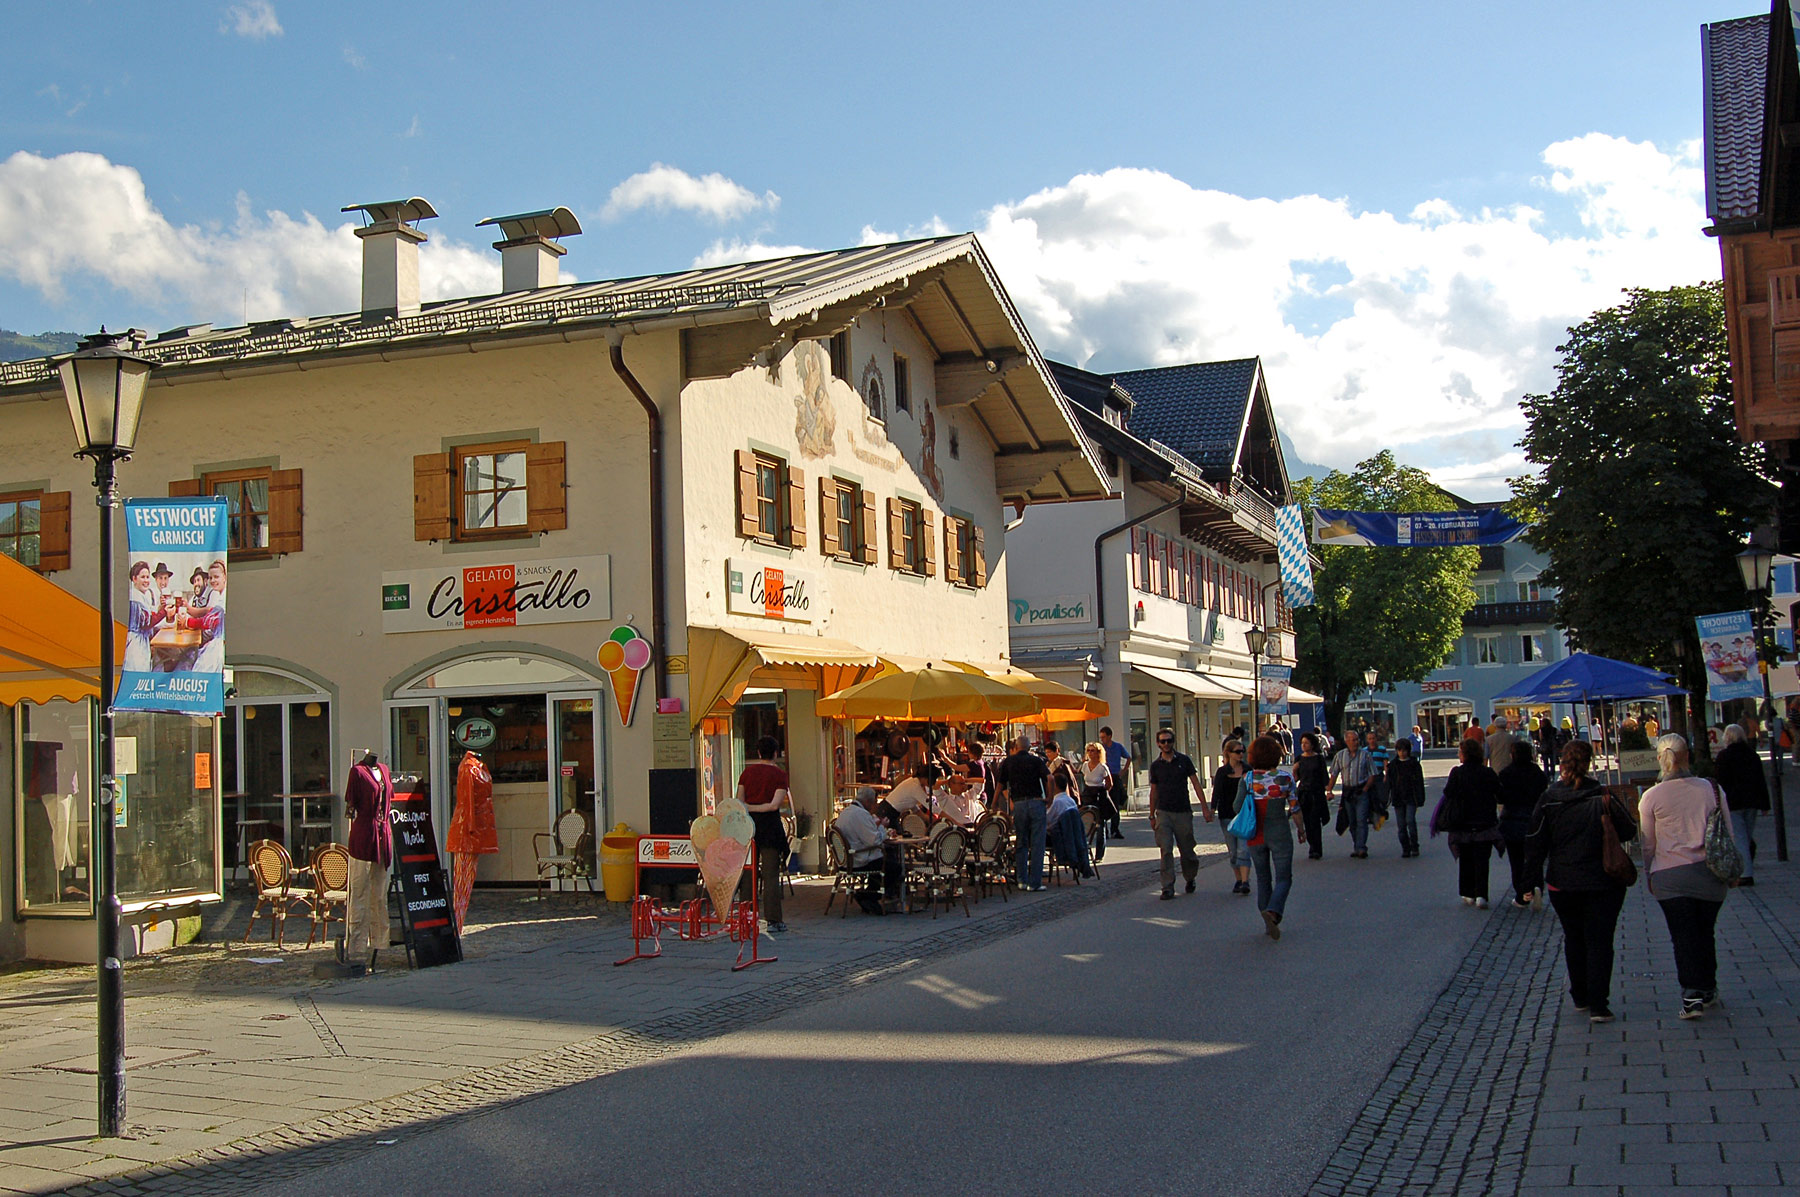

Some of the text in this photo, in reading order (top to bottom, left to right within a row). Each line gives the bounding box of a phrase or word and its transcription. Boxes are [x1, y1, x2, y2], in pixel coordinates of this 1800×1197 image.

[134, 507, 217, 527] FESTWOCHE
[1438, 521, 1466, 529] FEBRUAR
[151, 530, 205, 545] GARMISCH
[466, 568, 512, 583] GELATO
[523, 565, 552, 576] SNACKS
[765, 569, 783, 582] GELATO
[427, 568, 591, 619] Cristallo
[750, 571, 810, 611] Cristallo
[168, 678, 209, 693] AUGUST
[1421, 680, 1462, 693] ESPRIT
[389, 809, 429, 829] Designer-
[403, 830, 425, 846] Mode
[413, 873, 430, 883] FIRST
[408, 898, 447, 911] SECONDHAND
